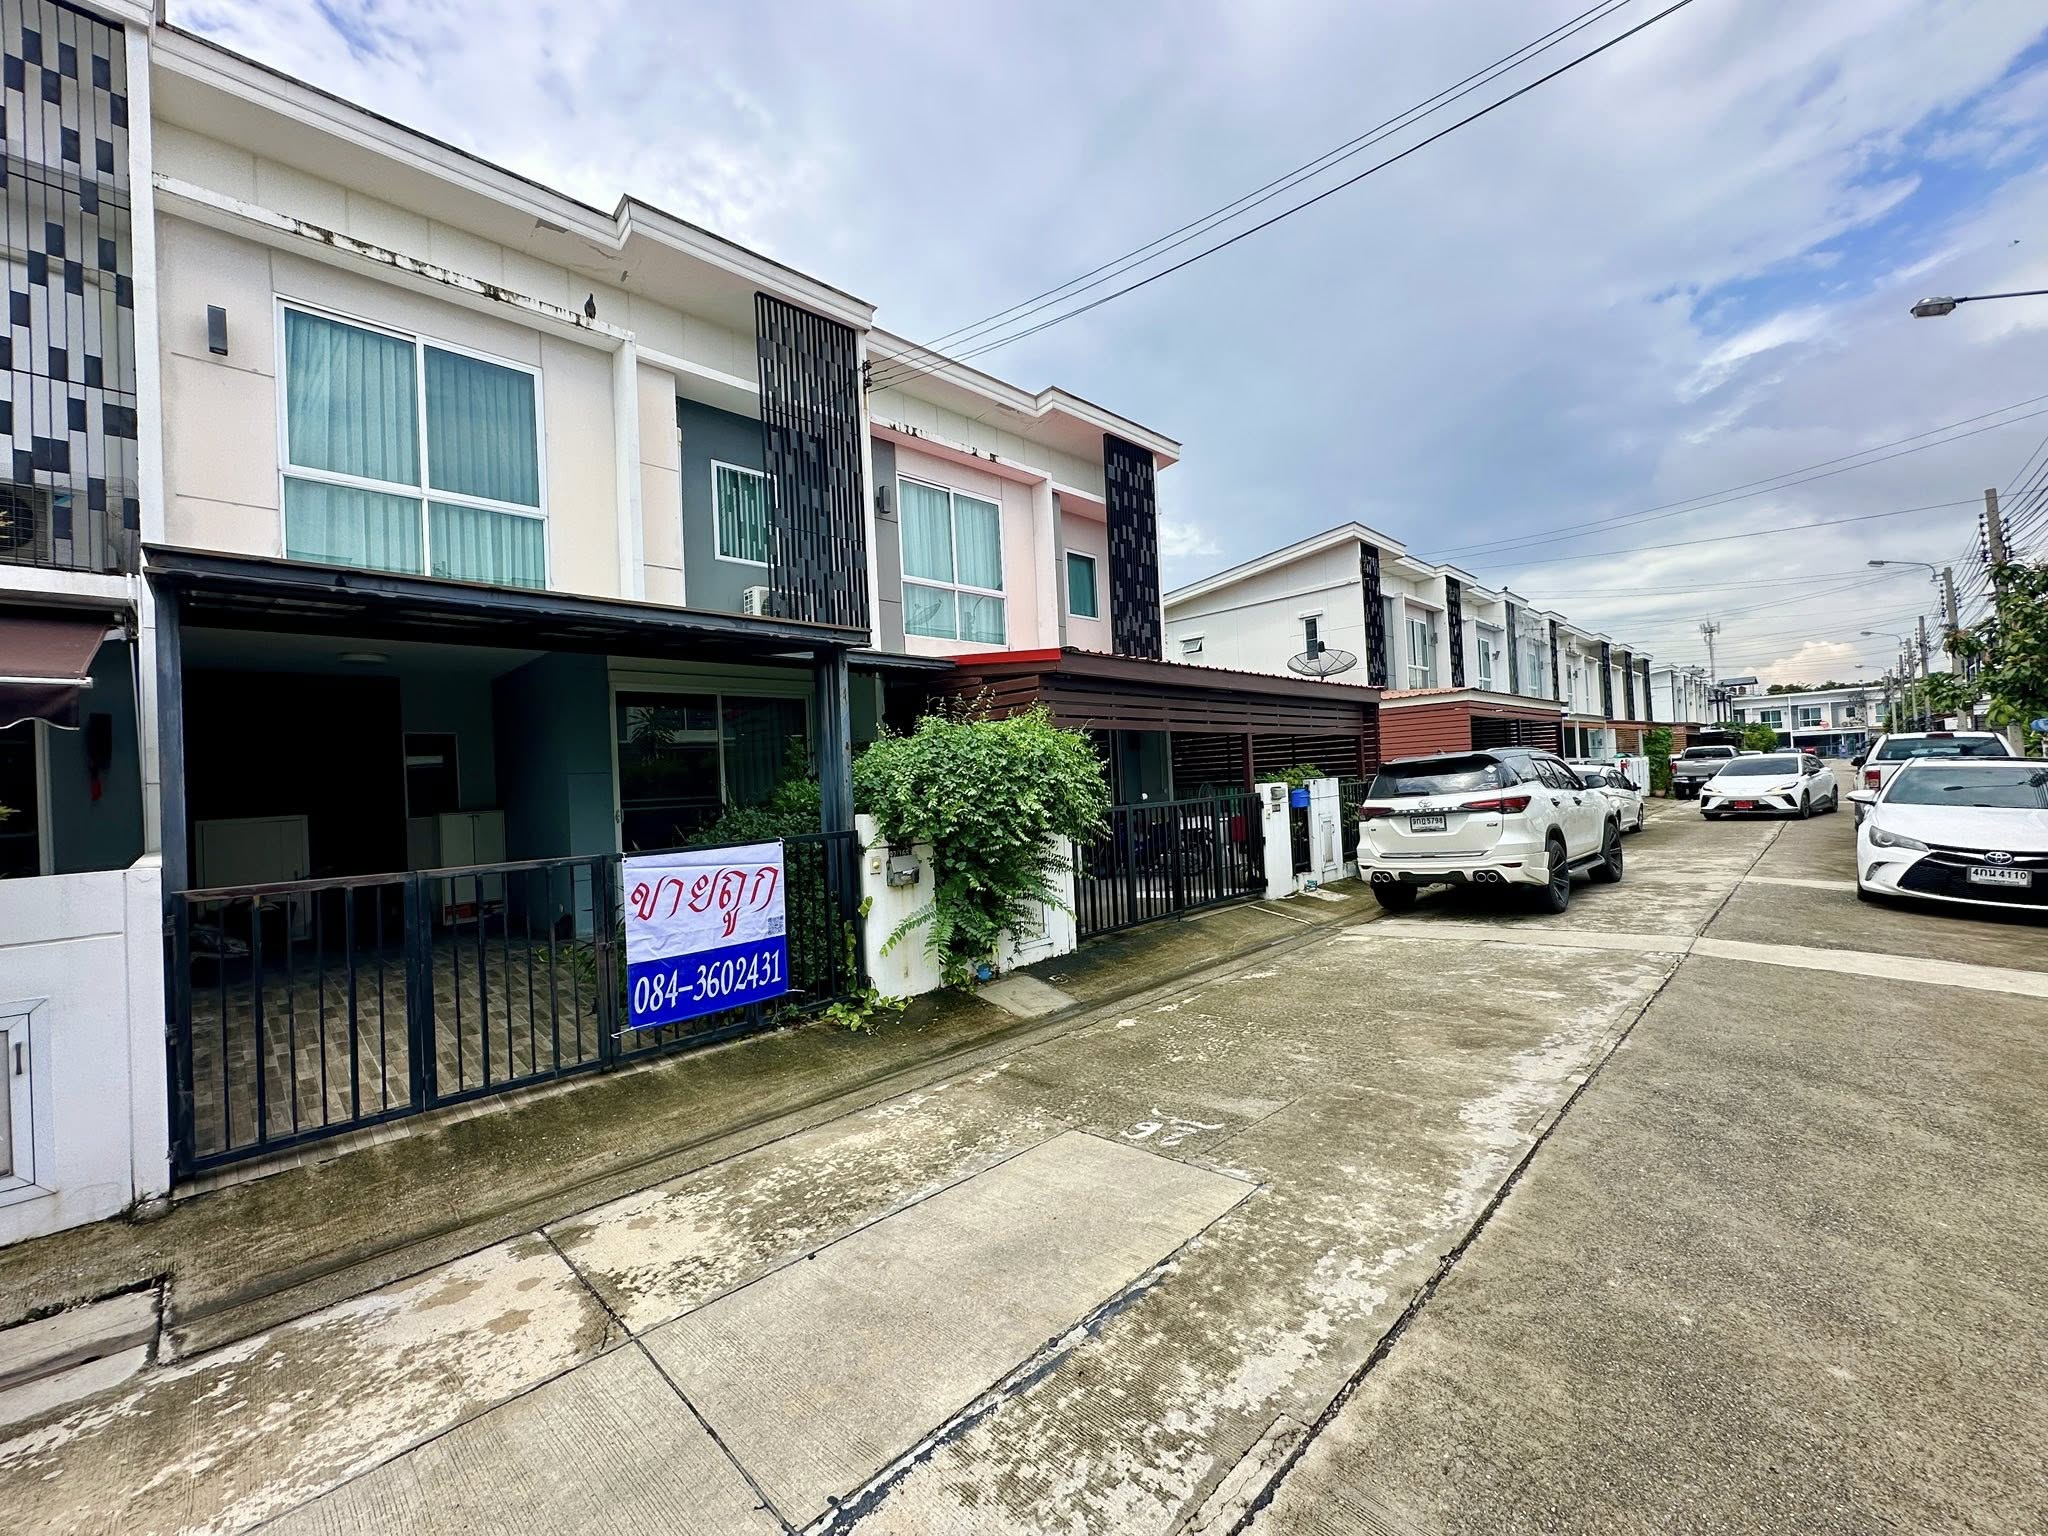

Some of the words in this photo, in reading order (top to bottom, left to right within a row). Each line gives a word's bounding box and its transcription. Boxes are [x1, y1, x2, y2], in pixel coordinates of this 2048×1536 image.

[630, 866, 779, 938] ขายถูก
[1972, 868, 1997, 877] 4กน
[1998, 870, 2027, 880] 4110
[634, 949, 782, 1015] 084-3602431
